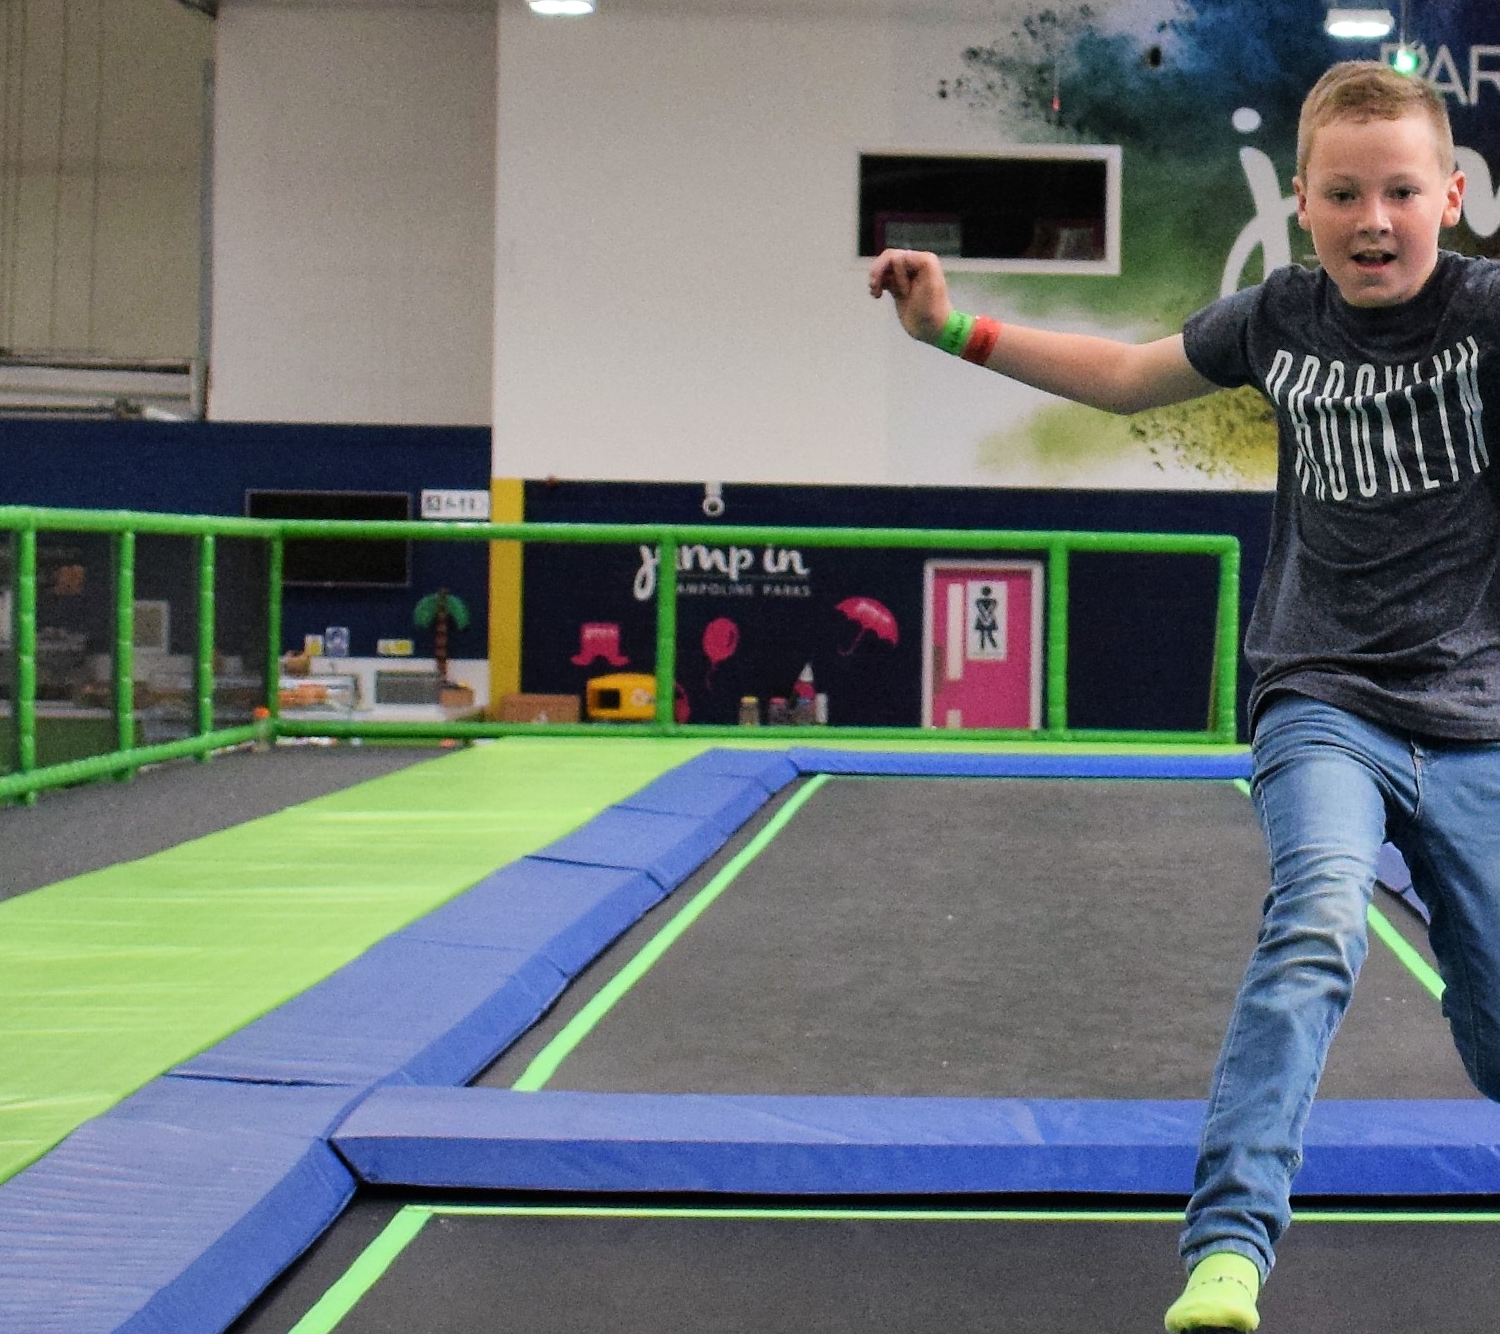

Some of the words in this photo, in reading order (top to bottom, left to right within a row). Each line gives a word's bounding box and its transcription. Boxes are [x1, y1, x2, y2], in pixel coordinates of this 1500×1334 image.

[1265, 335, 1491, 501] BROOKLYN
[632, 543, 754, 601] jmp
[762, 543, 811, 575] in
[677, 583, 754, 596] AMPOLINE
